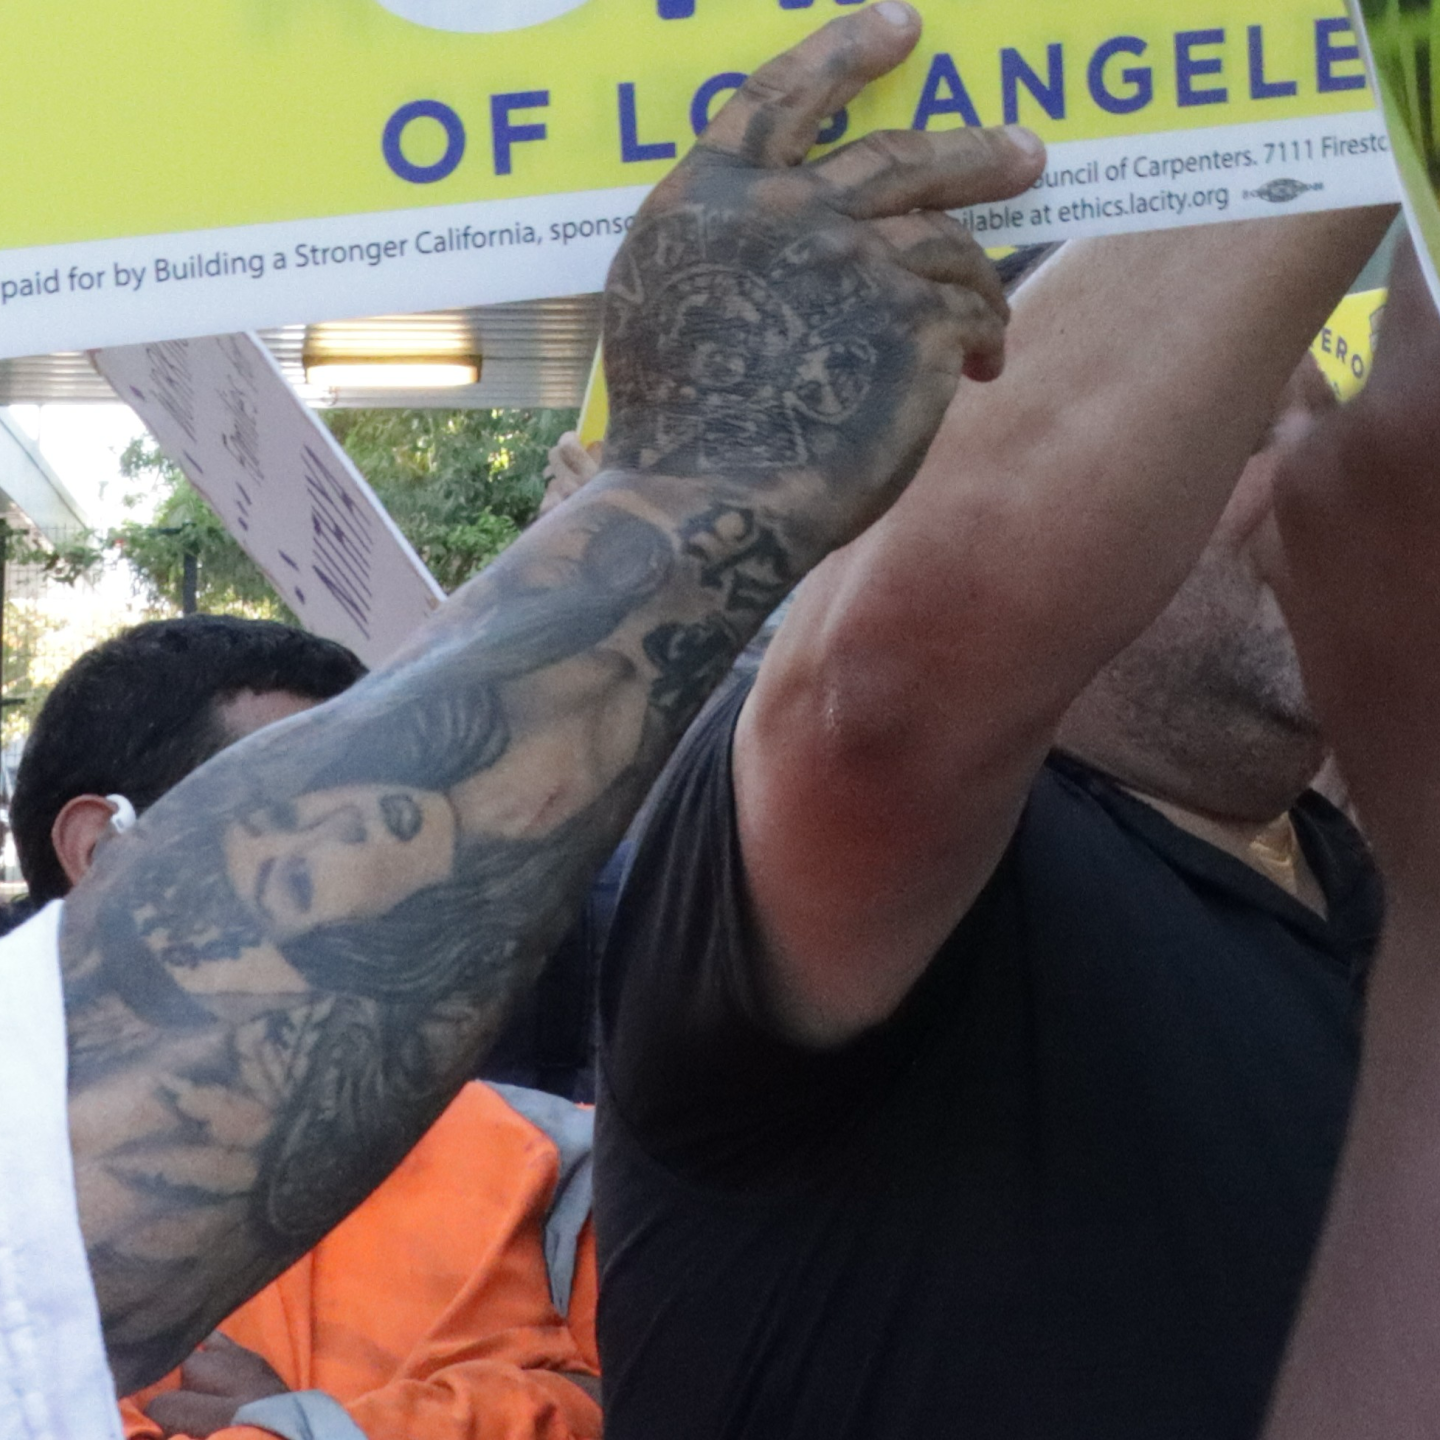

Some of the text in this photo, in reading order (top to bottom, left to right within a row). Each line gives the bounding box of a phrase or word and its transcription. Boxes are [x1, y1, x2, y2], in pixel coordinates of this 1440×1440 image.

[911, 17, 1368, 131] ANGELE
[382, 91, 550, 184] OF
[1105, 155, 1127, 182] of
[1264, 138, 1314, 163] 7111
[1031, 206, 1053, 227] at
[1057, 183, 1230, 223] ethics.lacity.org
[1, 269, 60, 304] paid
[68, 266, 106, 292] for
[113, 262, 146, 291] by
[155, 252, 265, 282] Building
[273, 252, 287, 270] a
[295, 238, 408, 267] Stronger
[415, 222, 542, 255] California,
